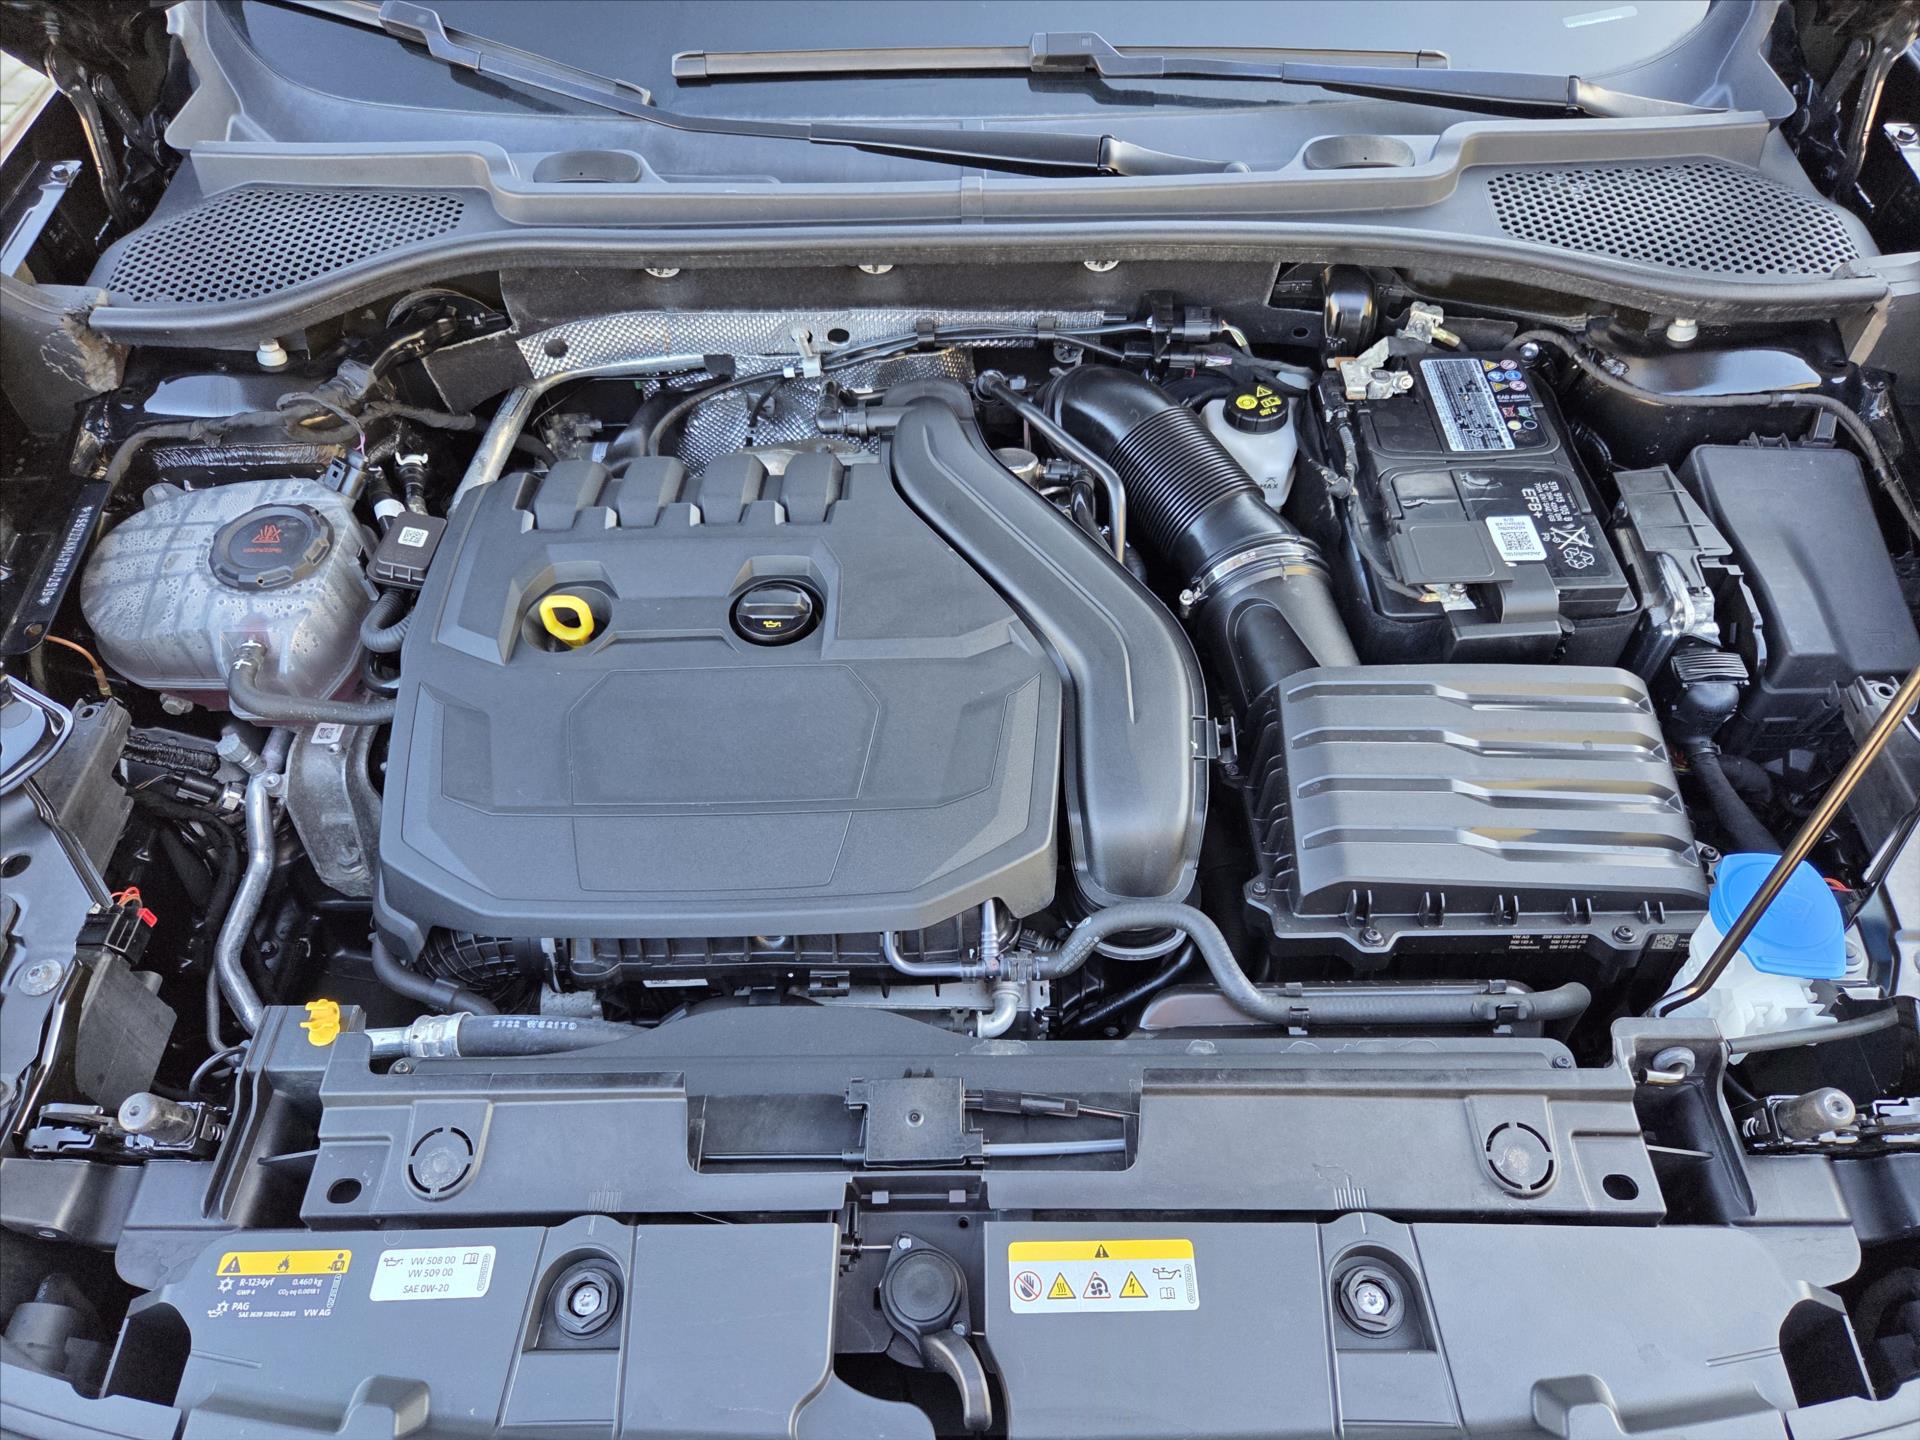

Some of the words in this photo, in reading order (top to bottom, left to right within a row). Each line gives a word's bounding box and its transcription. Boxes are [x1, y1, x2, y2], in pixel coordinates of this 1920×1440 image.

[1522, 488, 1543, 519] EFB+
[410, 1257, 426, 1265] VW
[427, 1257, 443, 1265] 508
[444, 1256, 456, 1264] 00
[408, 1269, 424, 1278] VW
[424, 1269, 440, 1277] 509
[442, 1268, 454, 1277] 00
[402, 1285, 420, 1294] SAE
[421, 1284, 450, 1293] 0W-20
[231, 1302, 250, 1311] PAG
[303, 1309, 319, 1317] VW
